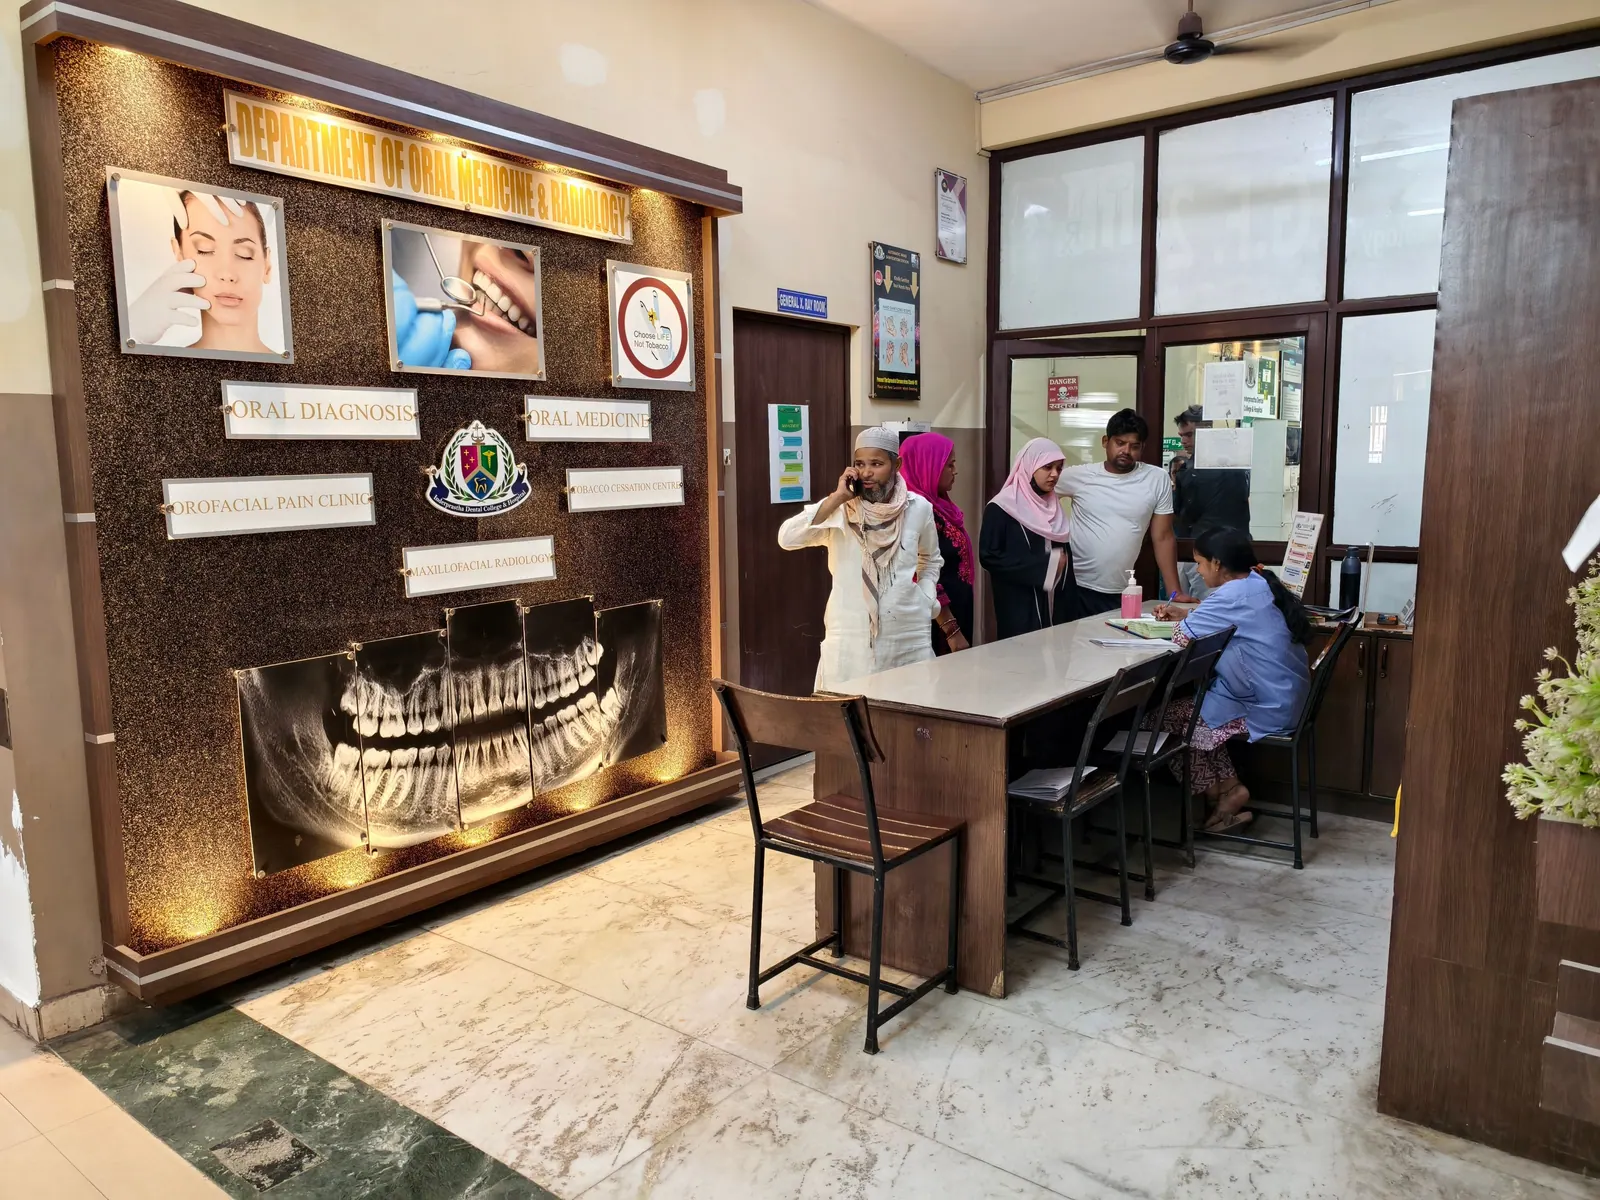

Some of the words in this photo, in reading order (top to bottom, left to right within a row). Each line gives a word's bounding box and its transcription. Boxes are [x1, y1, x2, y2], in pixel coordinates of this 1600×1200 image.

[235, 100, 377, 184] DEPARTMENT
[380, 137, 404, 189] OF
[409, 143, 456, 201] ORAL
[457, 156, 535, 218] MEDICINE
[537, 183, 549, 220] &
[550, 179, 626, 237] RADIOLOGY
[779, 294, 799, 309] GENERAL
[804, 298, 813, 311] RAY
[633, 330, 656, 340] Choose
[634, 340, 645, 348] Not
[646, 341, 669, 350] Tobacco
[231, 399, 296, 420] ORAL
[300, 402, 415, 422] DIAGNOSIS
[529, 409, 574, 427] ORAL
[576, 411, 650, 429] MEDICINE
[612, 482, 651, 493] CESSATION
[652, 481, 681, 491] CENTRE
[171, 496, 273, 516] OROFACIAL
[277, 495, 314, 510] PAIN
[318, 492, 370, 508] CLINIC
[433, 494, 464, 512] Inderprastha
[483, 504, 503, 512] College
[507, 490, 527, 506] Hospital
[409, 560, 493, 578] MAXILLOFACIAL
[494, 553, 552, 568] RADIOLOGY
